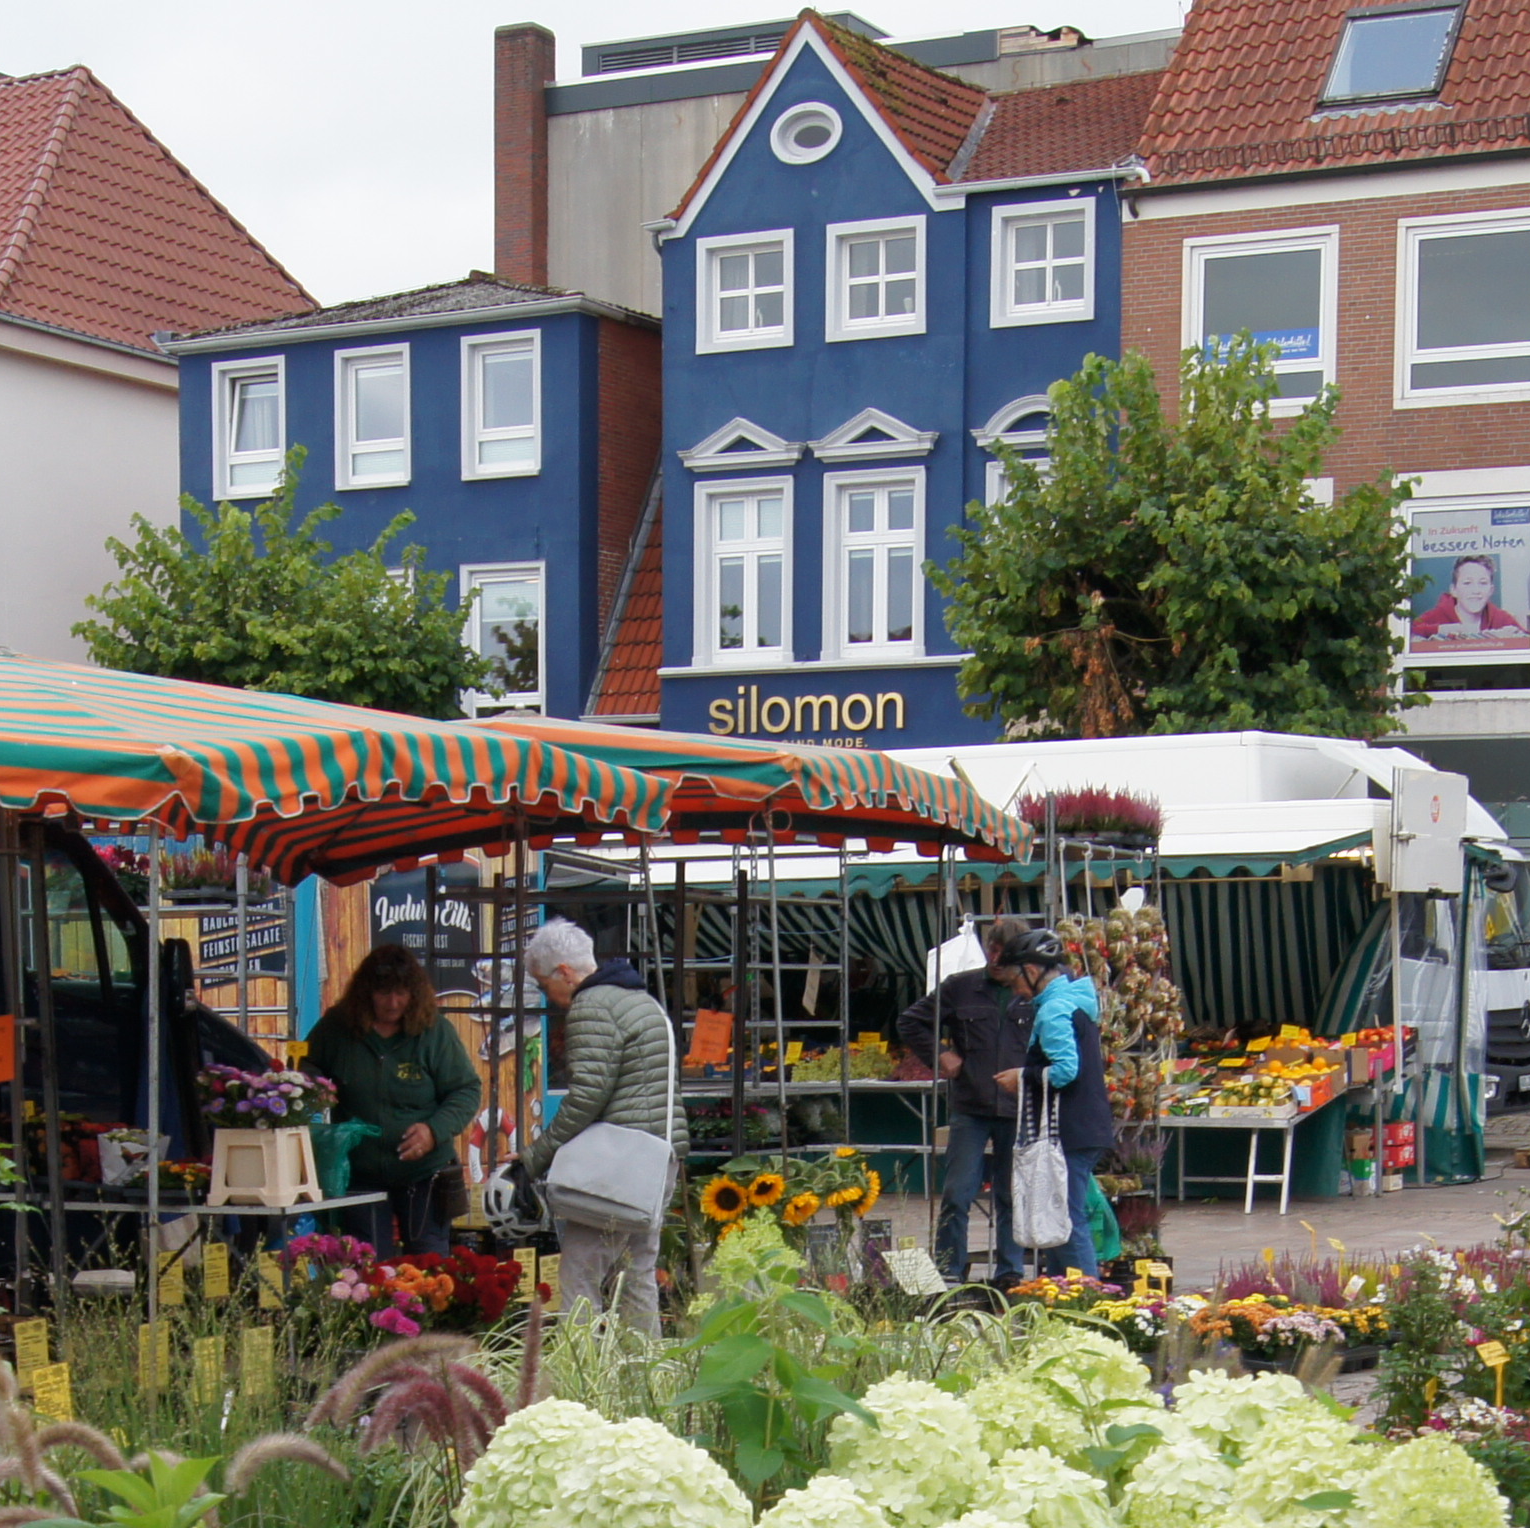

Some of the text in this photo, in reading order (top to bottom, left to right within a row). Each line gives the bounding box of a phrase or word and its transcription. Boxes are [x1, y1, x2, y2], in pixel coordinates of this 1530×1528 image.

[1428, 524, 1479, 536] In Zukunft
[1422, 534, 1526, 552] bessere Noten
[708, 684, 904, 735] silomon
[822, 737, 869, 748] MODE.
[245, 927, 281, 949] SALATE
